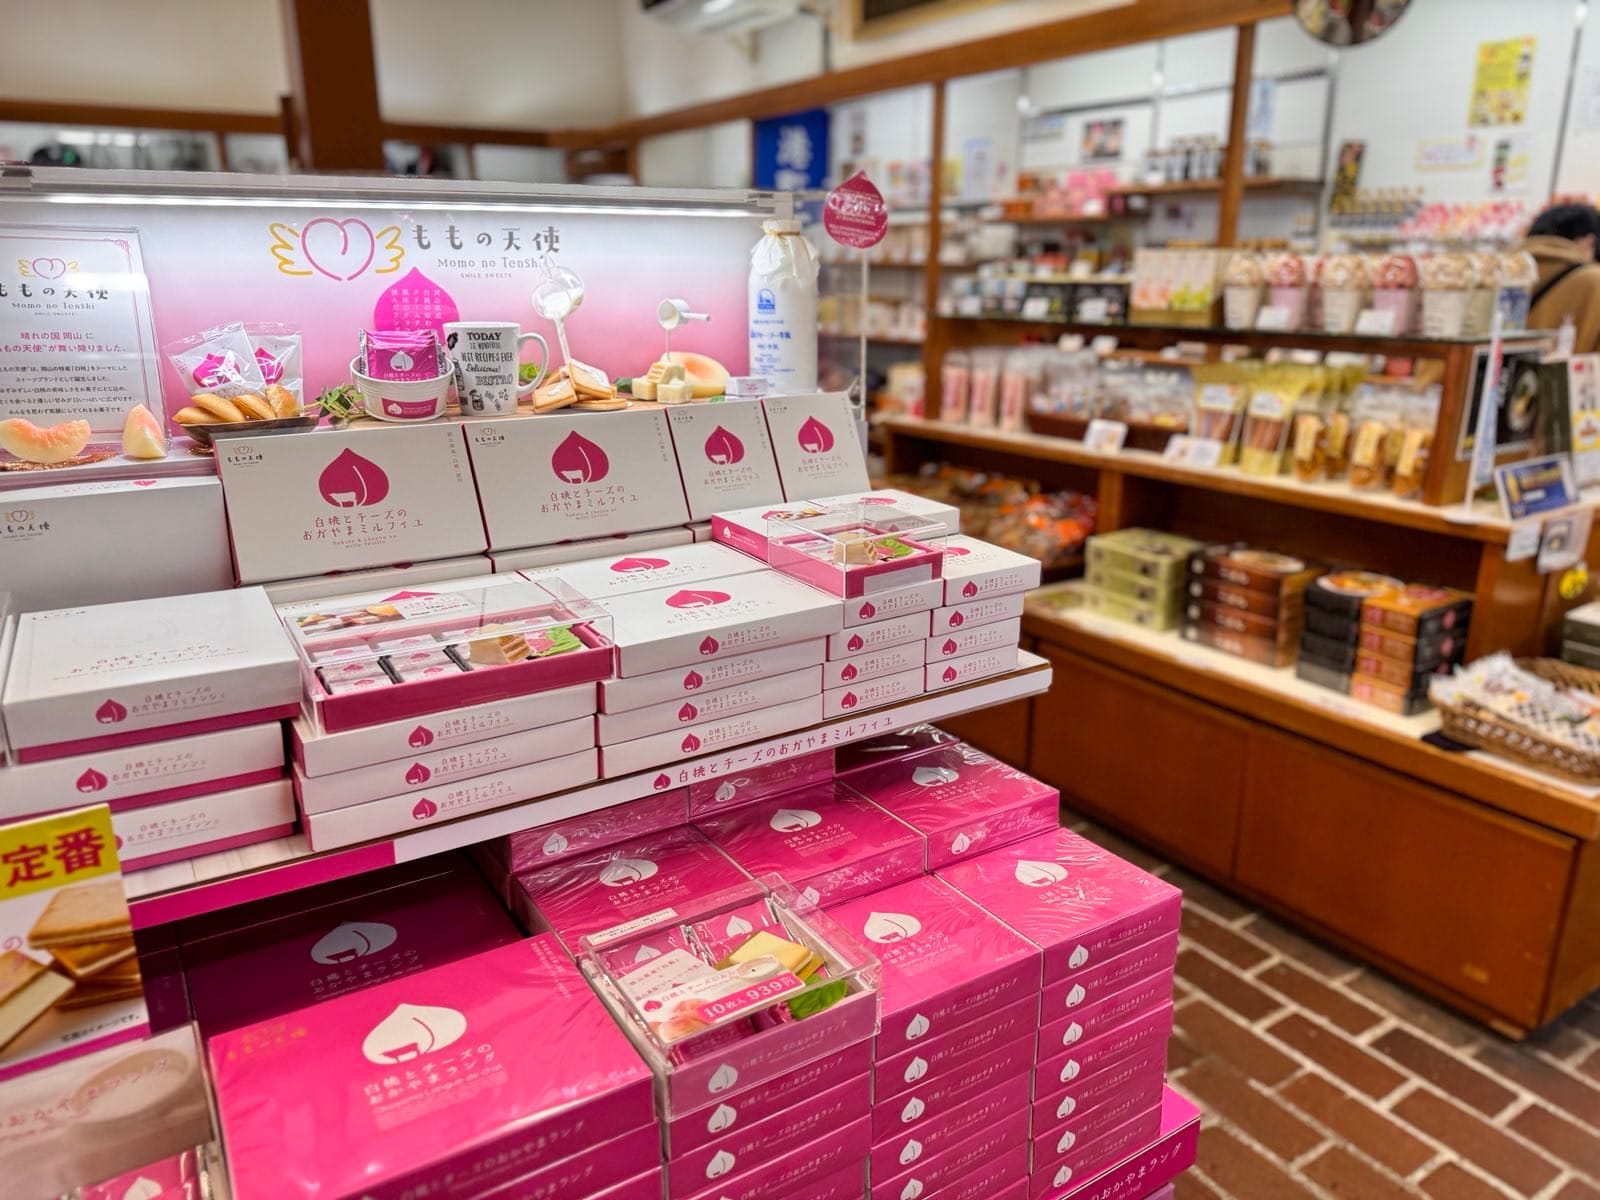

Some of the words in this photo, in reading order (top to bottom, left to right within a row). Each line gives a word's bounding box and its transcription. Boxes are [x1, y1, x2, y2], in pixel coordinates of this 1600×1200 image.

[412, 224, 560, 253] ももの天使
[438, 258, 475, 268] Momo
[482, 259, 496, 268] no
[467, 332, 501, 340] TODAY
[541, 495, 639, 513] おかやまミルフィユ
[551, 485, 625, 502] 白桃とチーズの
[303, 519, 424, 541] おかやまミルフィユ
[315, 508, 407, 528] 白桃とチーズの
[679, 717, 893, 784] 白桃とチーズのおかやまミルフィユ
[1, 827, 106, 888] 定番
[311, 949, 417, 988] 白桃とチーズの
[364, 1043, 493, 1095] 白桃とチーズの
[369, 1051, 495, 1106] おかやまラング
